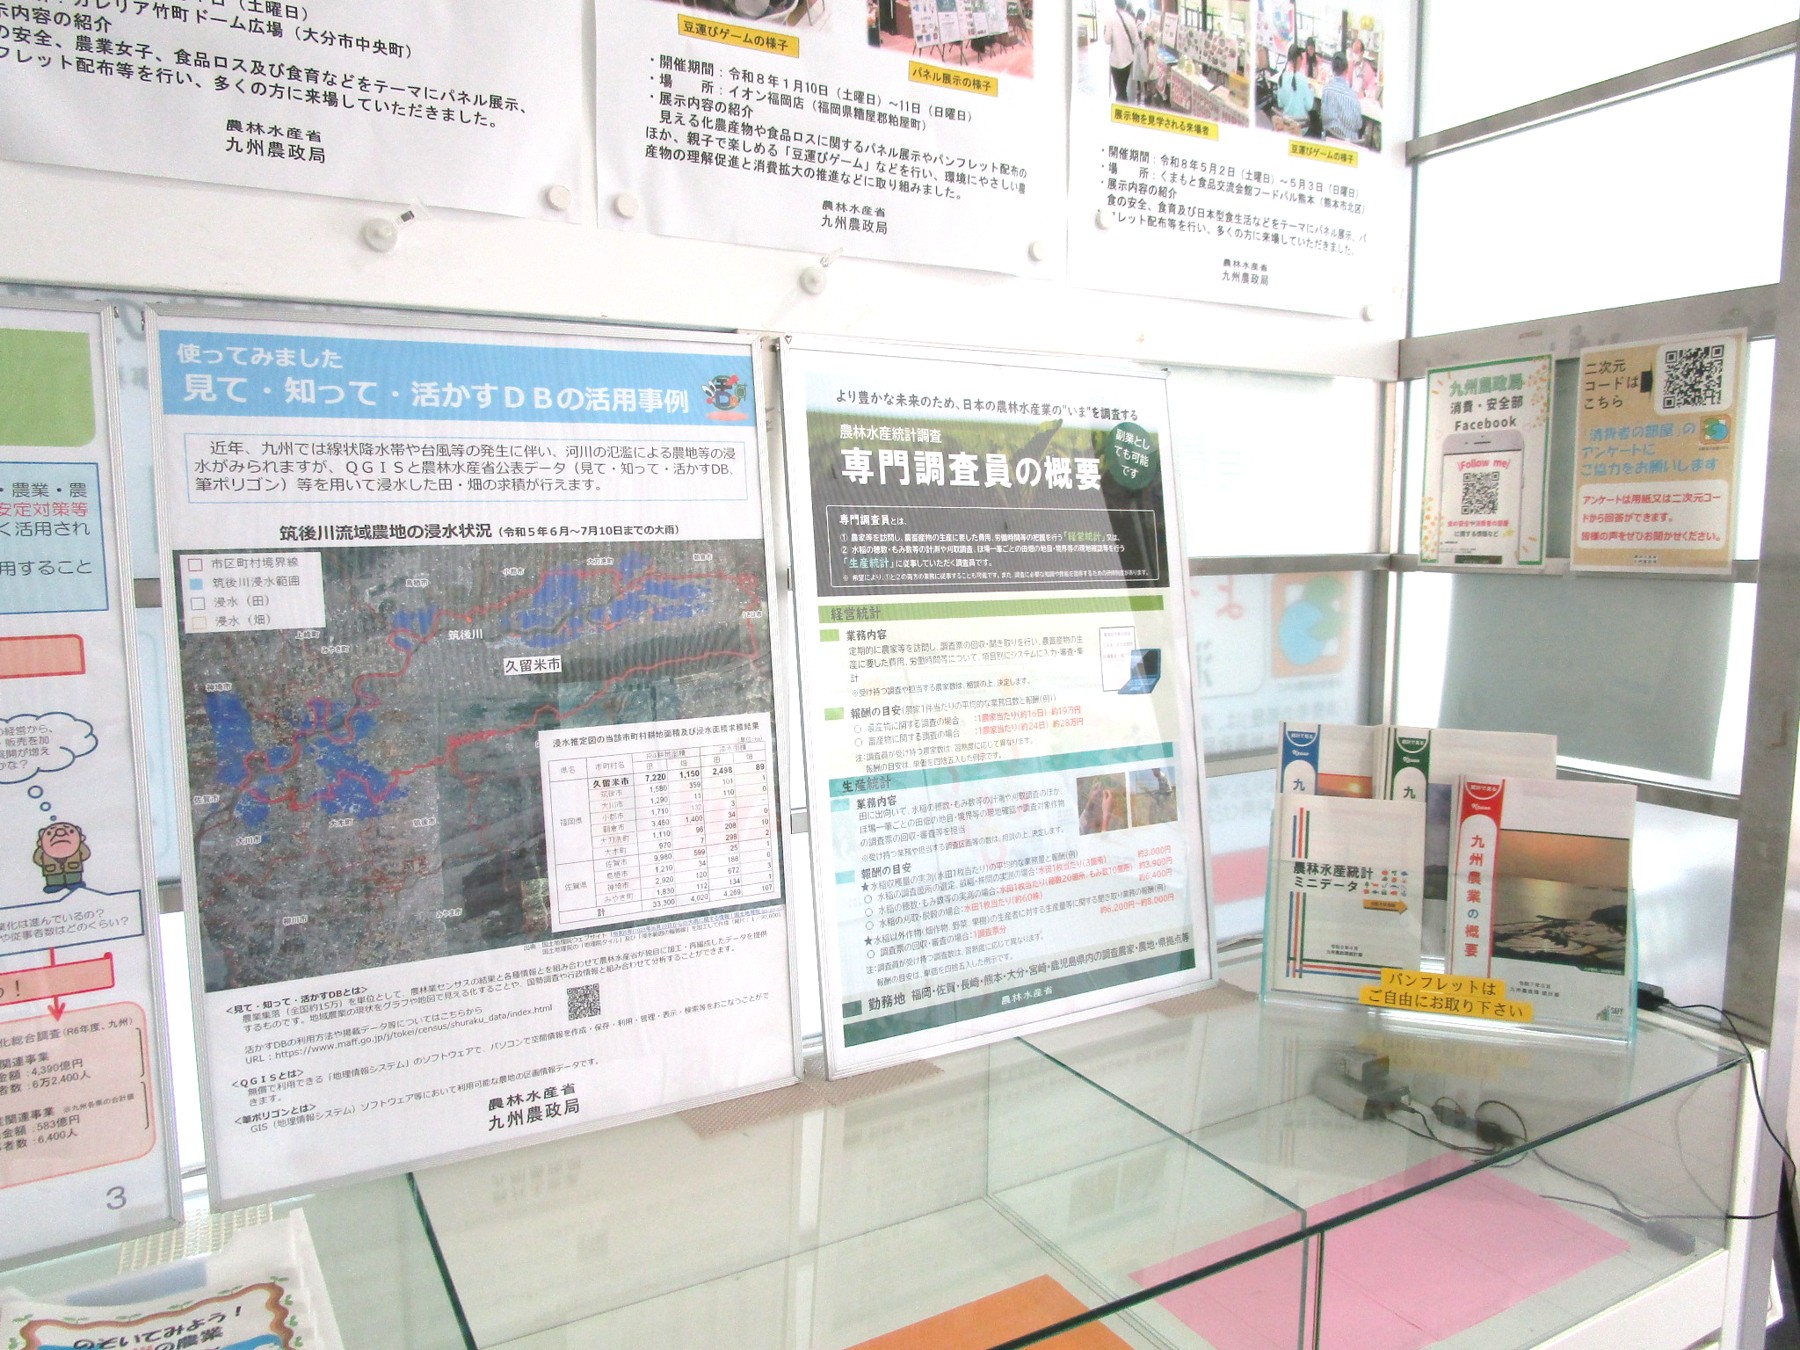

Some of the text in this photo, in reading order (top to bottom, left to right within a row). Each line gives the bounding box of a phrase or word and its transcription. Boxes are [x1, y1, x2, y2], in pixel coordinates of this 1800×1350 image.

[683, 20, 789, 52] 豆運びゲームの様子
[913, 67, 992, 91] パネル展示の様子
[226, 118, 322, 143] 農林水産省
[1114, 108, 1210, 136] 展示物を見学される来場者
[225, 136, 326, 164] 九州農政局
[1291, 144, 1355, 164] 豆運びゲームの様子
[645, 144, 963, 201] 産物の理解促進と消費拡大の推進などに取り組みました。
[822, 200, 886, 218] 農林水産省
[821, 215, 888, 235] 九州農政局
[1097, 208, 1355, 256] レット配布等を行い、多くの方に来場していただきました。
[1223, 258, 1268, 272] 農林水産省
[1222, 271, 1269, 286] 九州農政局
[177, 343, 343, 370] 使ってみました
[1584, 359, 1627, 376] 二次元
[1584, 376, 1639, 392] コードは
[184, 373, 690, 415] 見て・知って・活かすDBの活用事例
[1584, 395, 1624, 410] こちら
[1450, 395, 1524, 415] 消費・安全部
[1454, 416, 1518, 432] Facebook
[840, 424, 943, 444] 農林水産統計調査
[1115, 428, 1151, 450] 副業とし
[210, 440, 736, 462] 近年、九州では線状降水帯や台風等の発生に伴い、河川の氾濫による農地等の浸
[1114, 444, 1149, 467] ても可能
[1581, 443, 1656, 459] アンケートに
[840, 448, 1102, 491] 専門調査員の概要
[1121, 464, 1139, 480] です
[1580, 457, 1719, 477] ご協力をお願いします
[1582, 492, 1722, 505] アンケートは用紙又は二次元コー
[0, 502, 89, 518] 安定対策等
[1582, 512, 1673, 523] ドから回答ができます。
[0, 559, 93, 576] 用すること
[211, 557, 300, 570] 市区町村境界線
[212, 575, 301, 588] 筑後川浸水範囲
[831, 606, 882, 621] 経営統計
[448, 629, 484, 641] 筑後川
[846, 629, 887, 642] 業務内容
[505, 658, 561, 673] 久留米市
[593, 763, 765, 789] 久留米市 7,220 1,150 2,498 89
[842, 775, 891, 794] 生産統計
[1293, 778, 1305, 791] 九
[1403, 786, 1416, 799] 九
[856, 795, 897, 810] 業務内容
[861, 862, 912, 880] 報酬の目安
[1293, 861, 1374, 880] 農林水産統計
[1294, 876, 1358, 892] ミニデータ
[1464, 834, 1486, 959] 九州農業の概要
[1389, 973, 1496, 996] パンフレットは
[868, 992, 906, 1012] 勤務地
[1368, 989, 1524, 1018] ご自由にお取り下さい
[488, 1083, 576, 1111] 農林水産省
[488, 1098, 580, 1132] 九州農政局
[106, 1185, 128, 1211] 3
